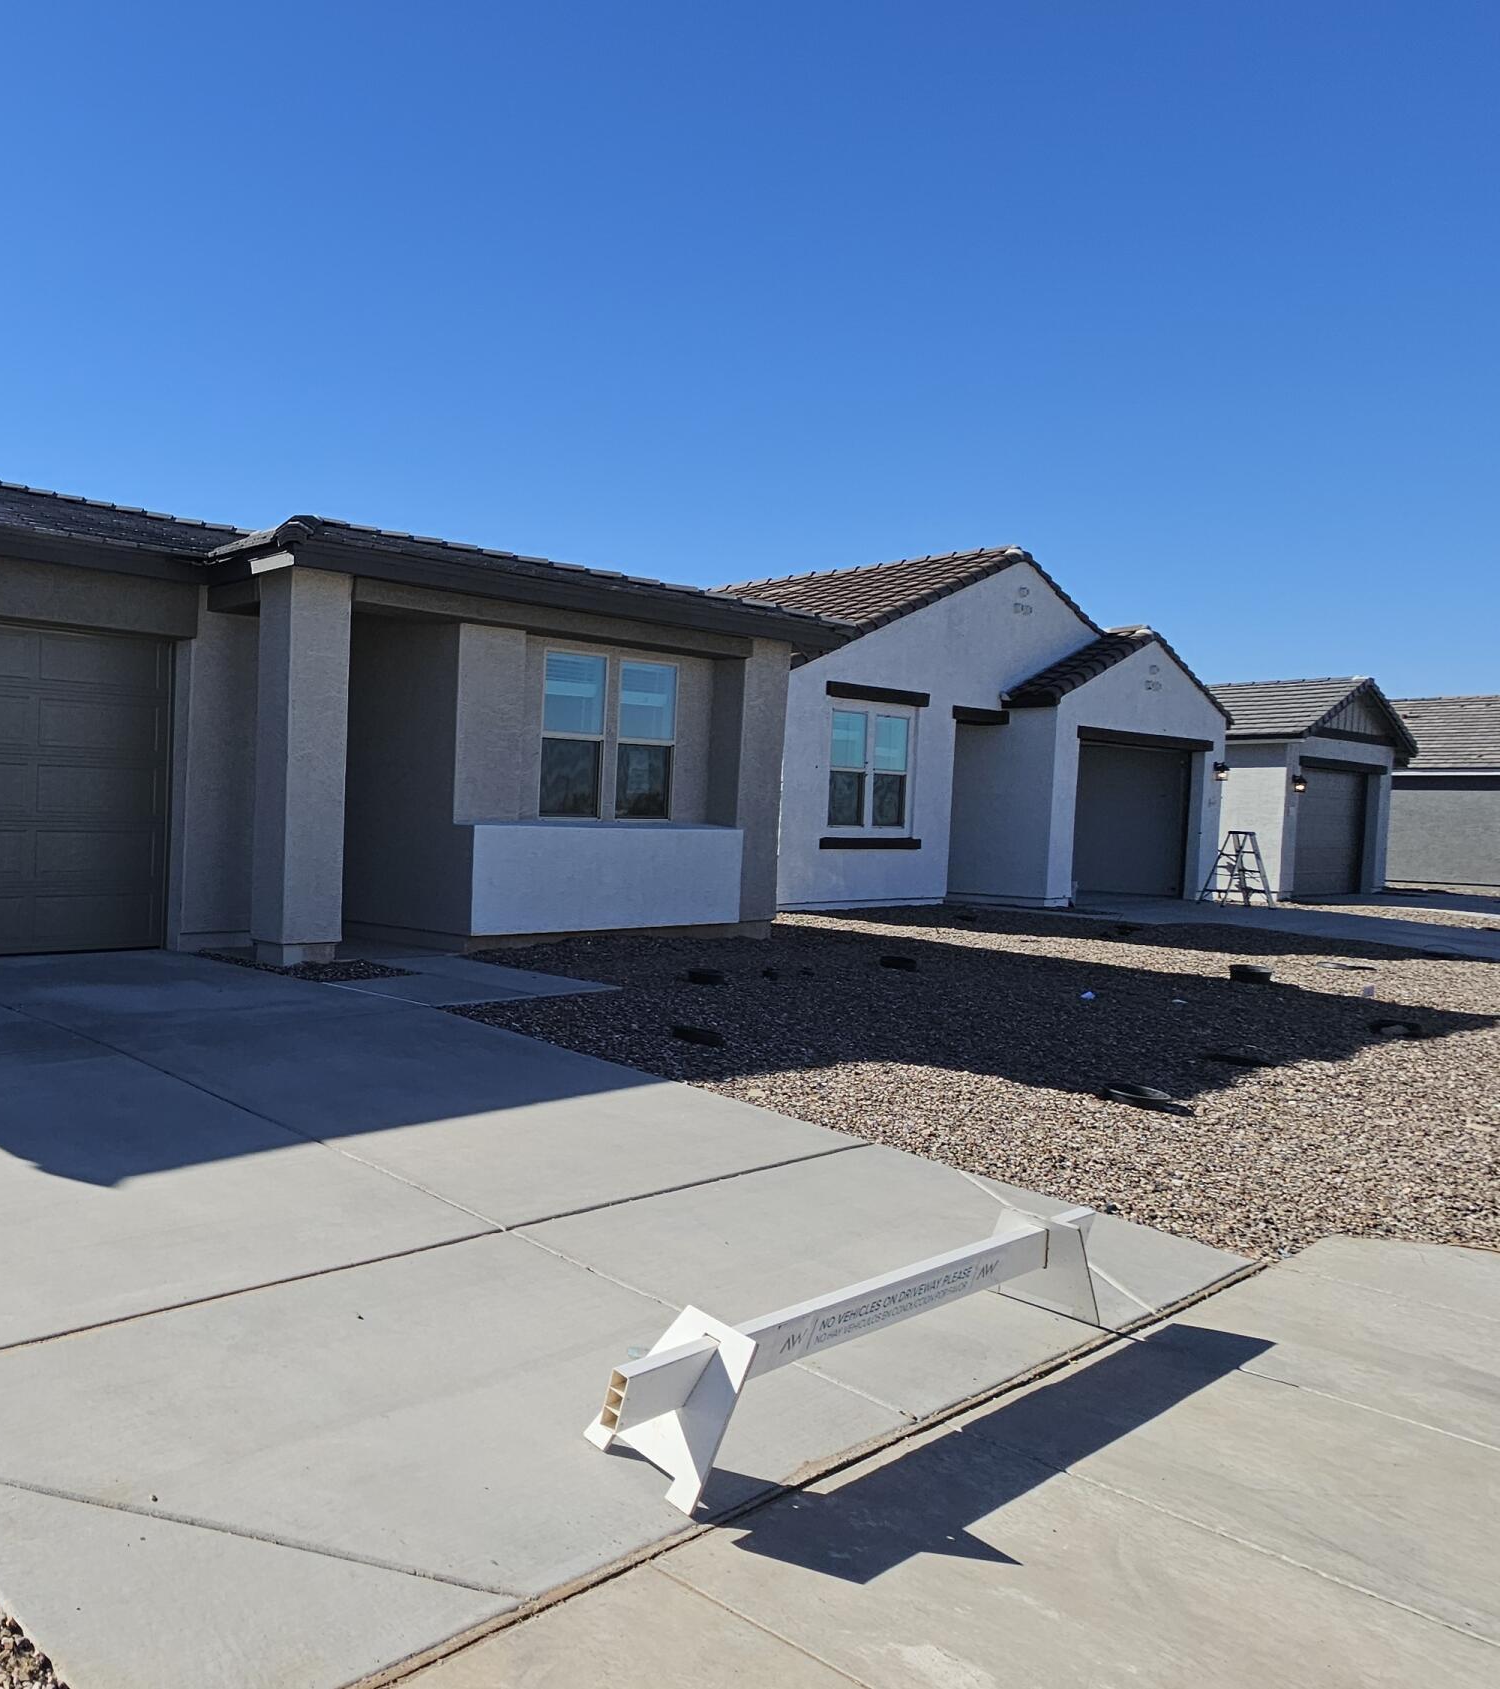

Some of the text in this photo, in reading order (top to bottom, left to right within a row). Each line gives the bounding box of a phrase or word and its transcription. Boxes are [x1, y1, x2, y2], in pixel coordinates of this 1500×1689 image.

[819, 1266, 973, 1331] NO VEHICLES ON DRIVEWAY PLEASE
